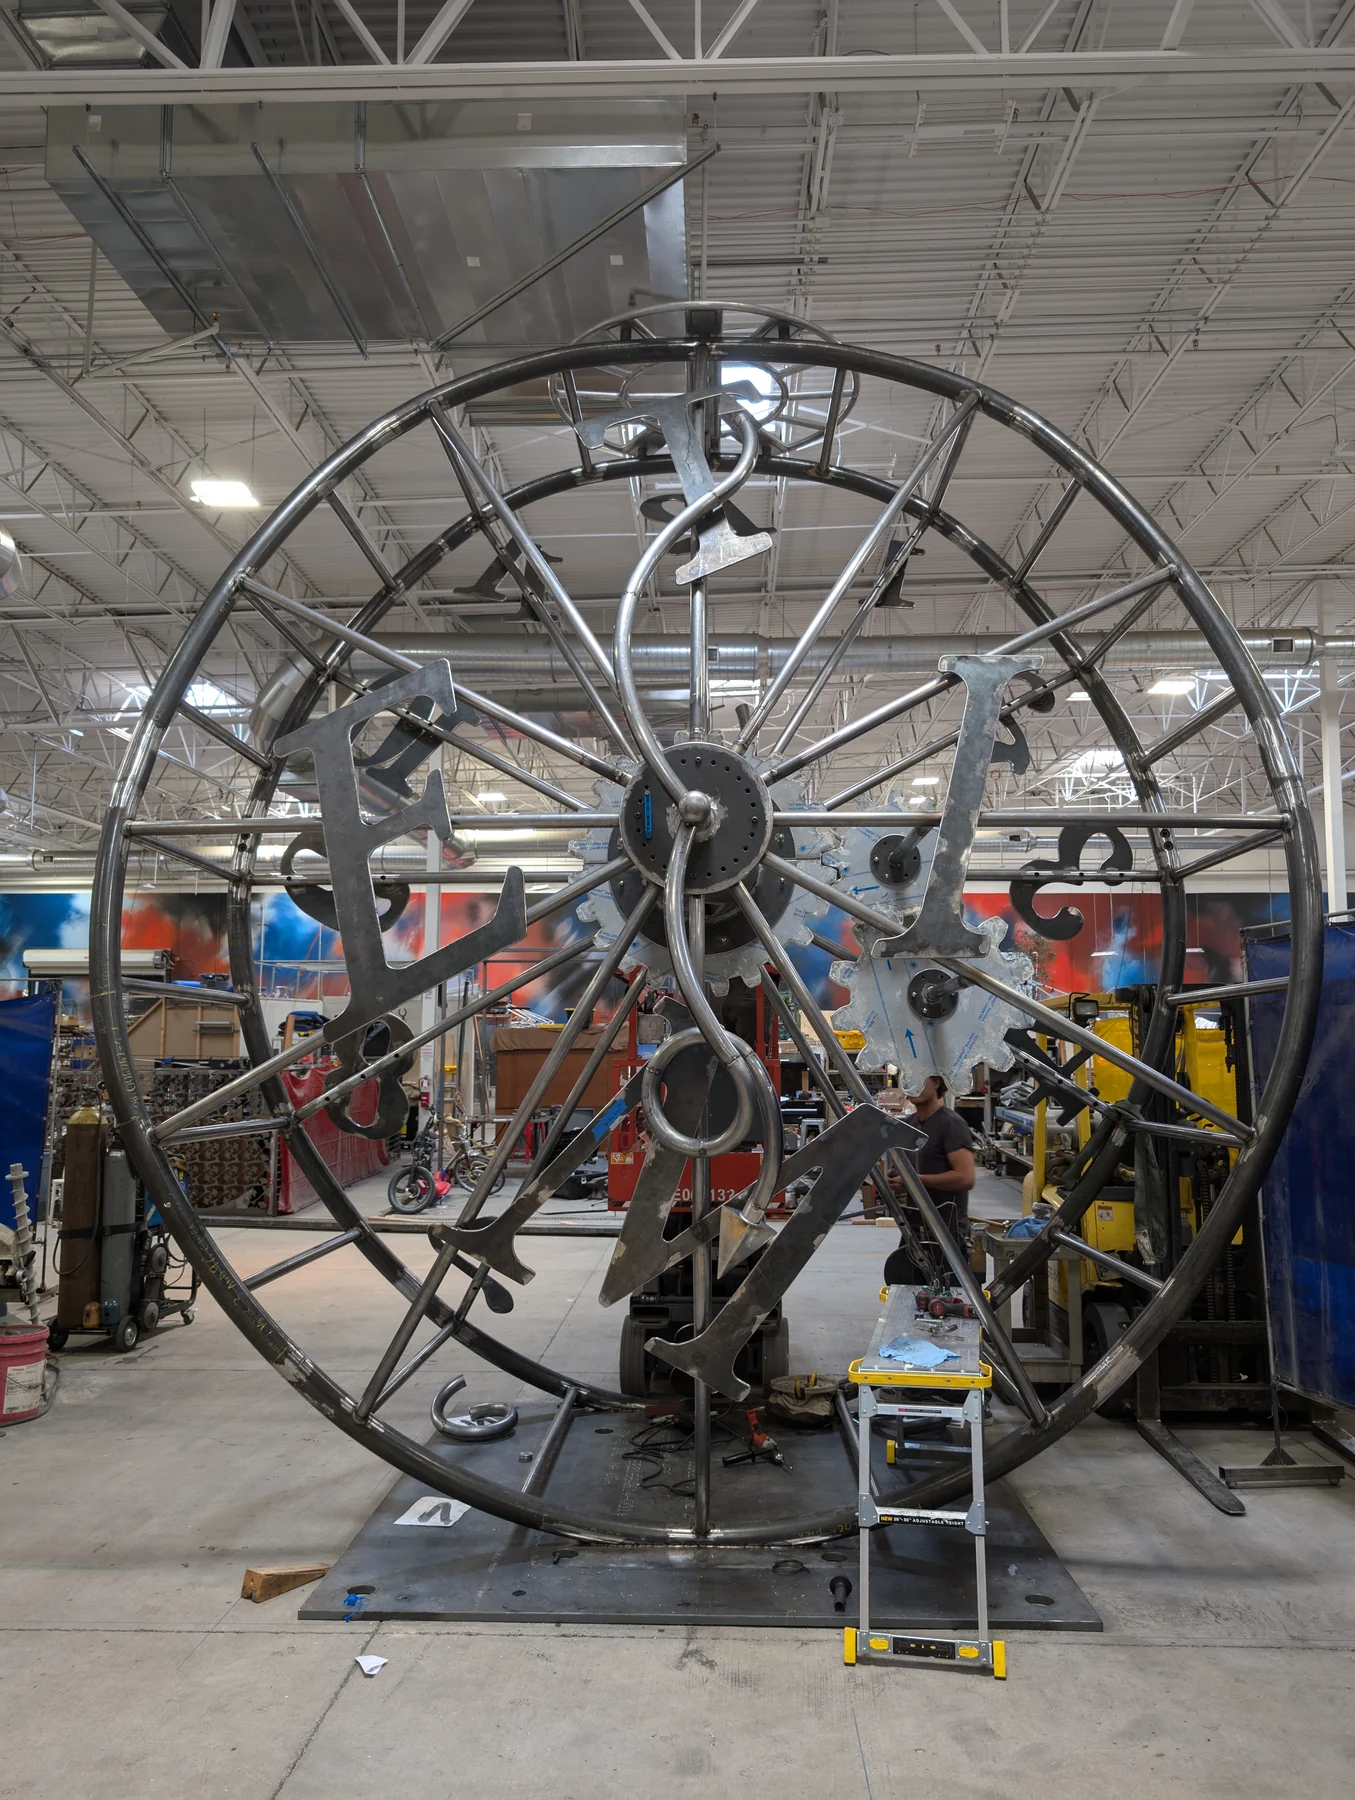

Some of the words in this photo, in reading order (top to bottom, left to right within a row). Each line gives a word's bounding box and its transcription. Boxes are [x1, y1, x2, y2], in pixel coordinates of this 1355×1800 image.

[573, 379, 773, 586] T
[272, 657, 528, 1043] E
[323, 1010, 417, 1141] 8
[912, 1517, 944, 1525] ADJUSTABLE
